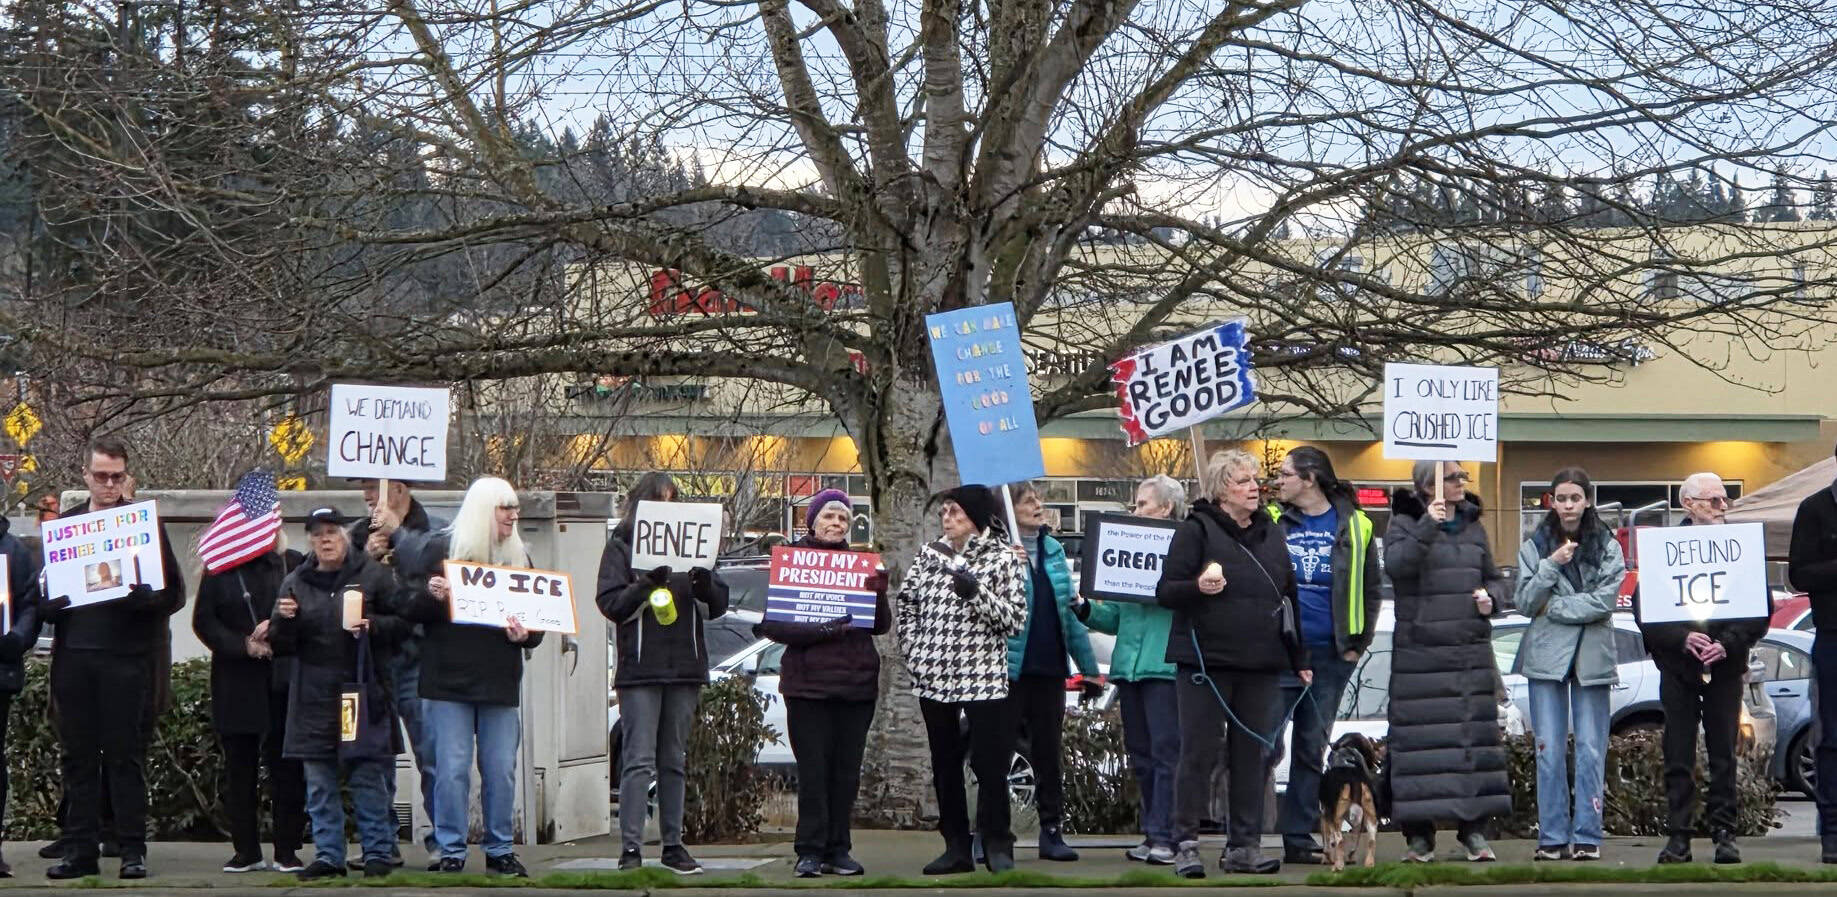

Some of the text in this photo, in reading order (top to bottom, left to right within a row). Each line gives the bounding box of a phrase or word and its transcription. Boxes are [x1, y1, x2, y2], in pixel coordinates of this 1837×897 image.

[957, 341, 1003, 360] CHANGE
[1139, 335, 1218, 377] I AM
[987, 364, 1012, 380] THE
[1129, 350, 1238, 411] RENEE
[973, 391, 1009, 410] GOOD
[1393, 378, 1496, 401] I ONLY LIKE
[346, 397, 432, 420] WE DEMAND
[1144, 380, 1238, 430] GOOD
[1000, 417, 1019, 431] ALL
[1393, 411, 1495, 441] CRUSHED ICE
[340, 430, 437, 467] CHANGE
[46, 509, 148, 543] JUSTICE FOR
[1107, 529, 1120, 537] the
[1143, 532, 1153, 541] of
[49, 532, 151, 564] RENEE GOOD
[636, 520, 712, 559] RENEE
[792, 550, 859, 570] NOT MY
[1665, 538, 1742, 567] DEFUND
[461, 566, 563, 597] NO ICE
[778, 567, 869, 588] PRESIDENT
[1122, 580, 1134, 588] the
[1672, 571, 1730, 607] ICE
[795, 603, 811, 612] NOT
[811, 605, 824, 613] MY
[799, 591, 816, 601] NOT
[816, 593, 827, 602] MY
